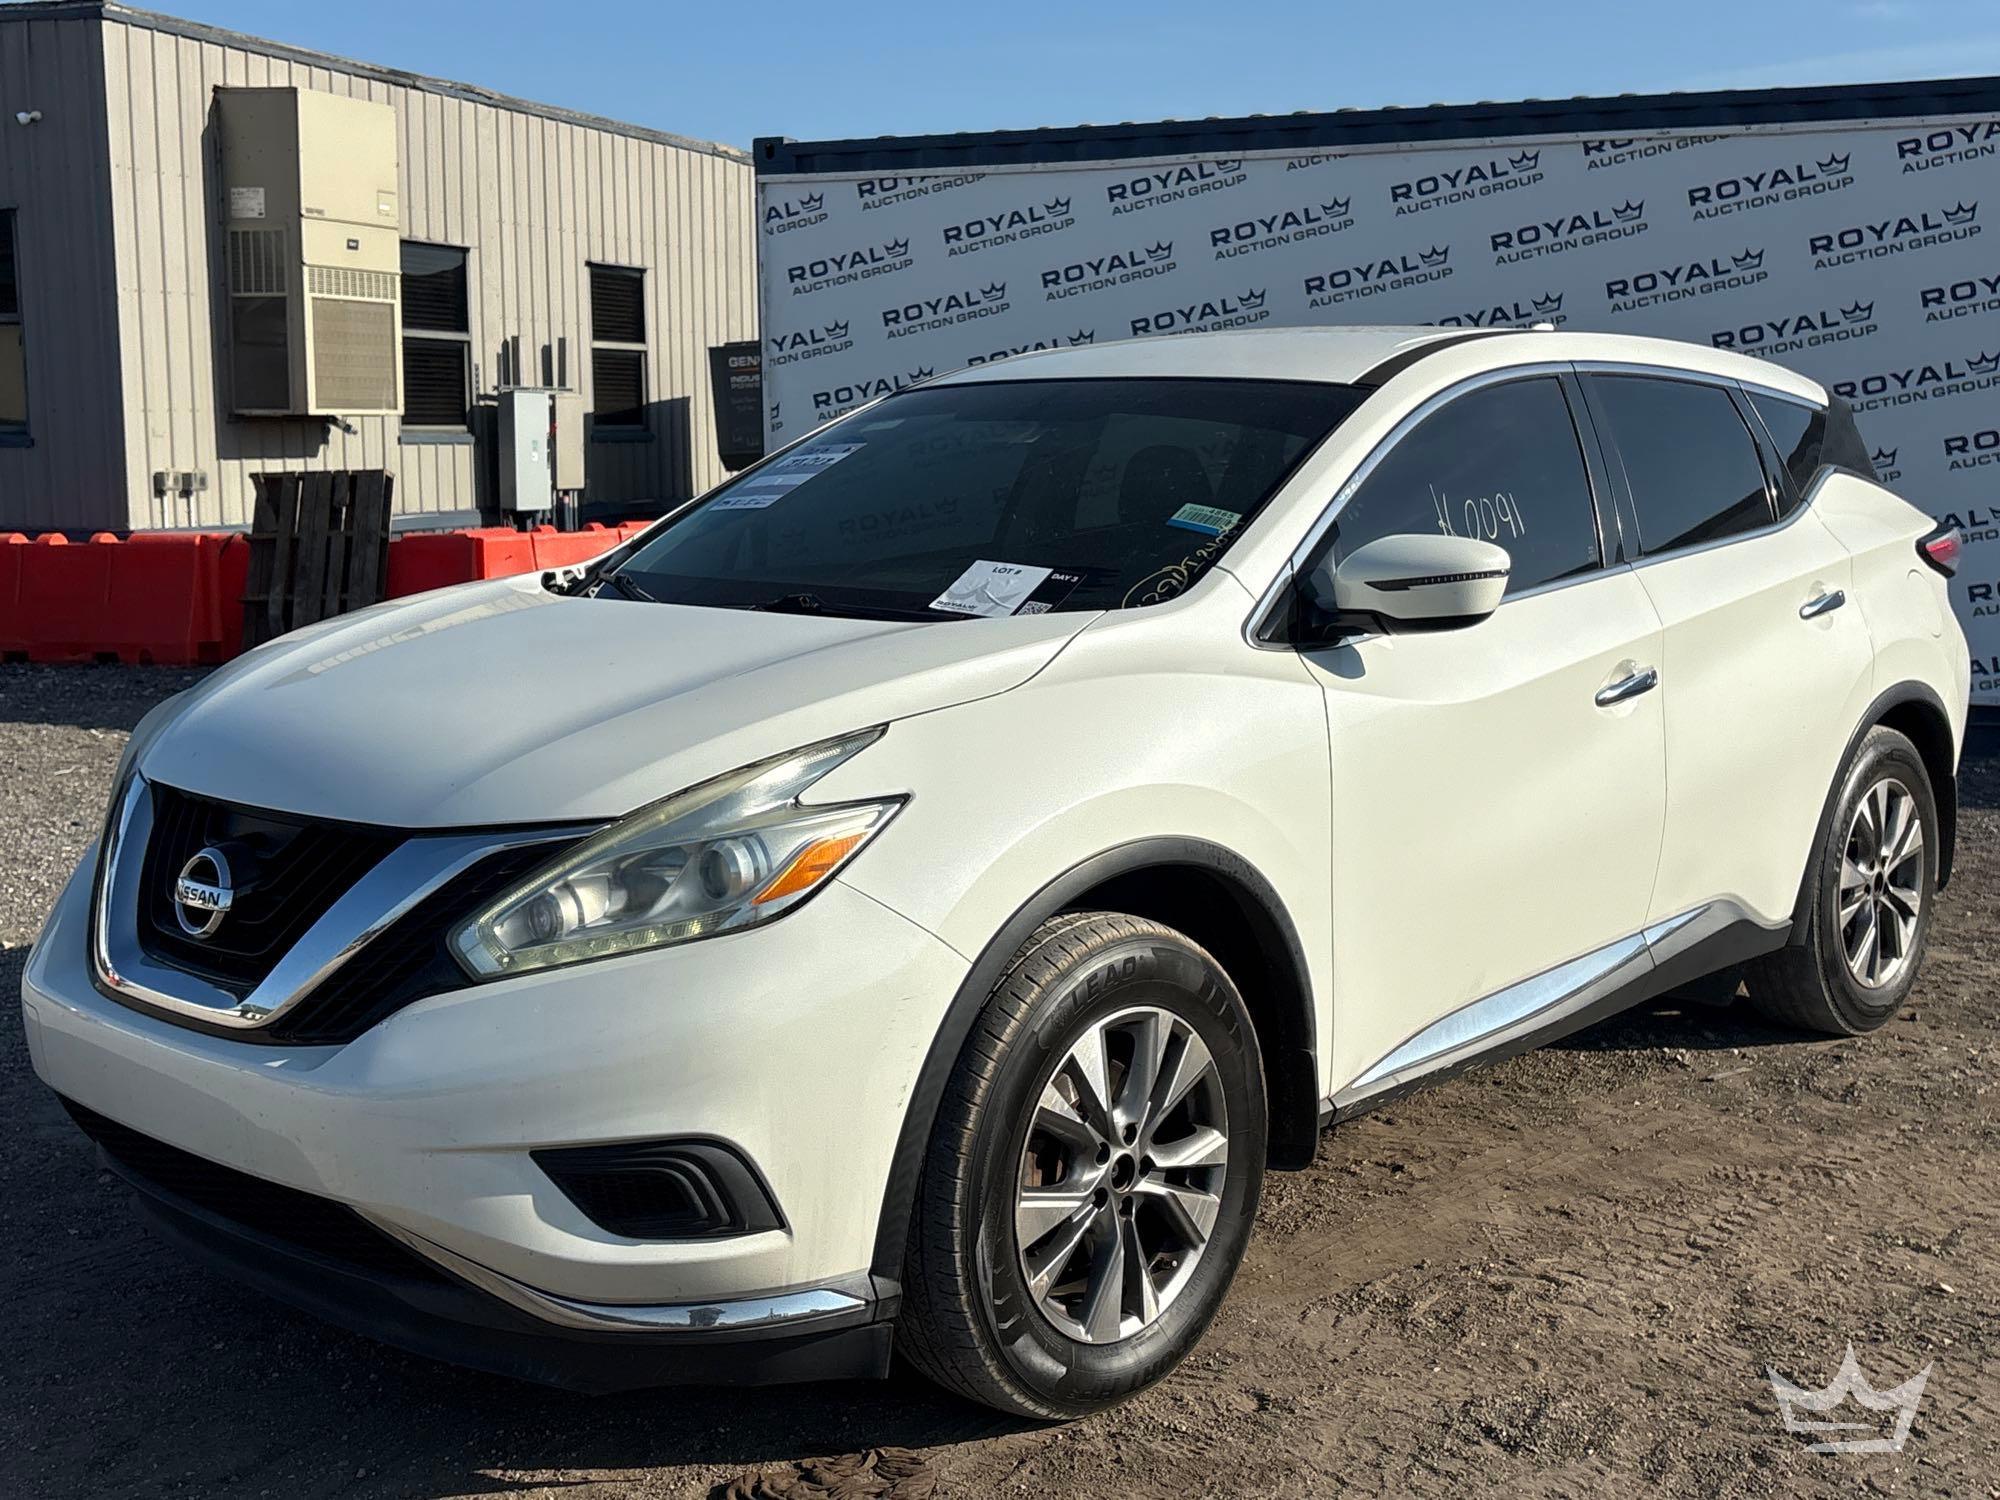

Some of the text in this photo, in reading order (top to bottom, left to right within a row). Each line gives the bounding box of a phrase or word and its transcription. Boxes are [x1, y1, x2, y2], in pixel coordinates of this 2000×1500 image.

[1587, 143, 1672, 171] AUCTION
[1902, 144, 1995, 175] AUCTION
[862, 173, 986, 211] AUCTION GROUP
[1107, 163, 1215, 202] ROYAL
[1112, 174, 1247, 216] AUCTION GROUP
[1391, 161, 1509, 202] ROYAL
[1395, 172, 1544, 217] AUCTION GROUP
[1688, 164, 1816, 206] ROYAL
[1693, 176, 1854, 221] AUCTION GROUP
[776, 213, 828, 233] GROUP
[943, 207, 1044, 244] ROYAL
[948, 218, 1075, 257] AUCTION GROUP
[1210, 207, 1321, 247] ROYAL
[1215, 219, 1354, 261] AUCTION GROUP
[1491, 211, 1612, 251] ROYAL
[1809, 212, 1942, 255] ROYAL
[1495, 222, 1648, 266] AUCTION GROUP
[1814, 225, 1981, 270] AUCTION GROUP
[788, 248, 885, 283] ROYAL
[792, 258, 913, 296] AUCTION GROUP
[1041, 251, 1146, 288] ROYAL
[1046, 262, 1176, 302] AUCTION GROUP
[1304, 256, 1419, 295] ROYAL
[1606, 258, 1731, 299] ROYAL
[1309, 267, 1453, 309] AUCTION GROUP
[1610, 270, 1768, 314] AUCTION GROUP
[882, 291, 981, 327] ROYAL
[887, 302, 1011, 340] AUCTION GROUP
[1130, 298, 1238, 336] ROYAL
[1211, 310, 1270, 332] GROUP
[1712, 311, 1840, 349] ROYAL
[1808, 324, 1878, 348] GROUP
[802, 340, 853, 359] GROUP
[813, 375, 909, 409] ROYAL
[1833, 361, 1966, 399] ROYAL
[1851, 390, 1927, 413] UCTION
[992, 566, 1012, 575] LOT
[1051, 573, 1070, 582] DAY
